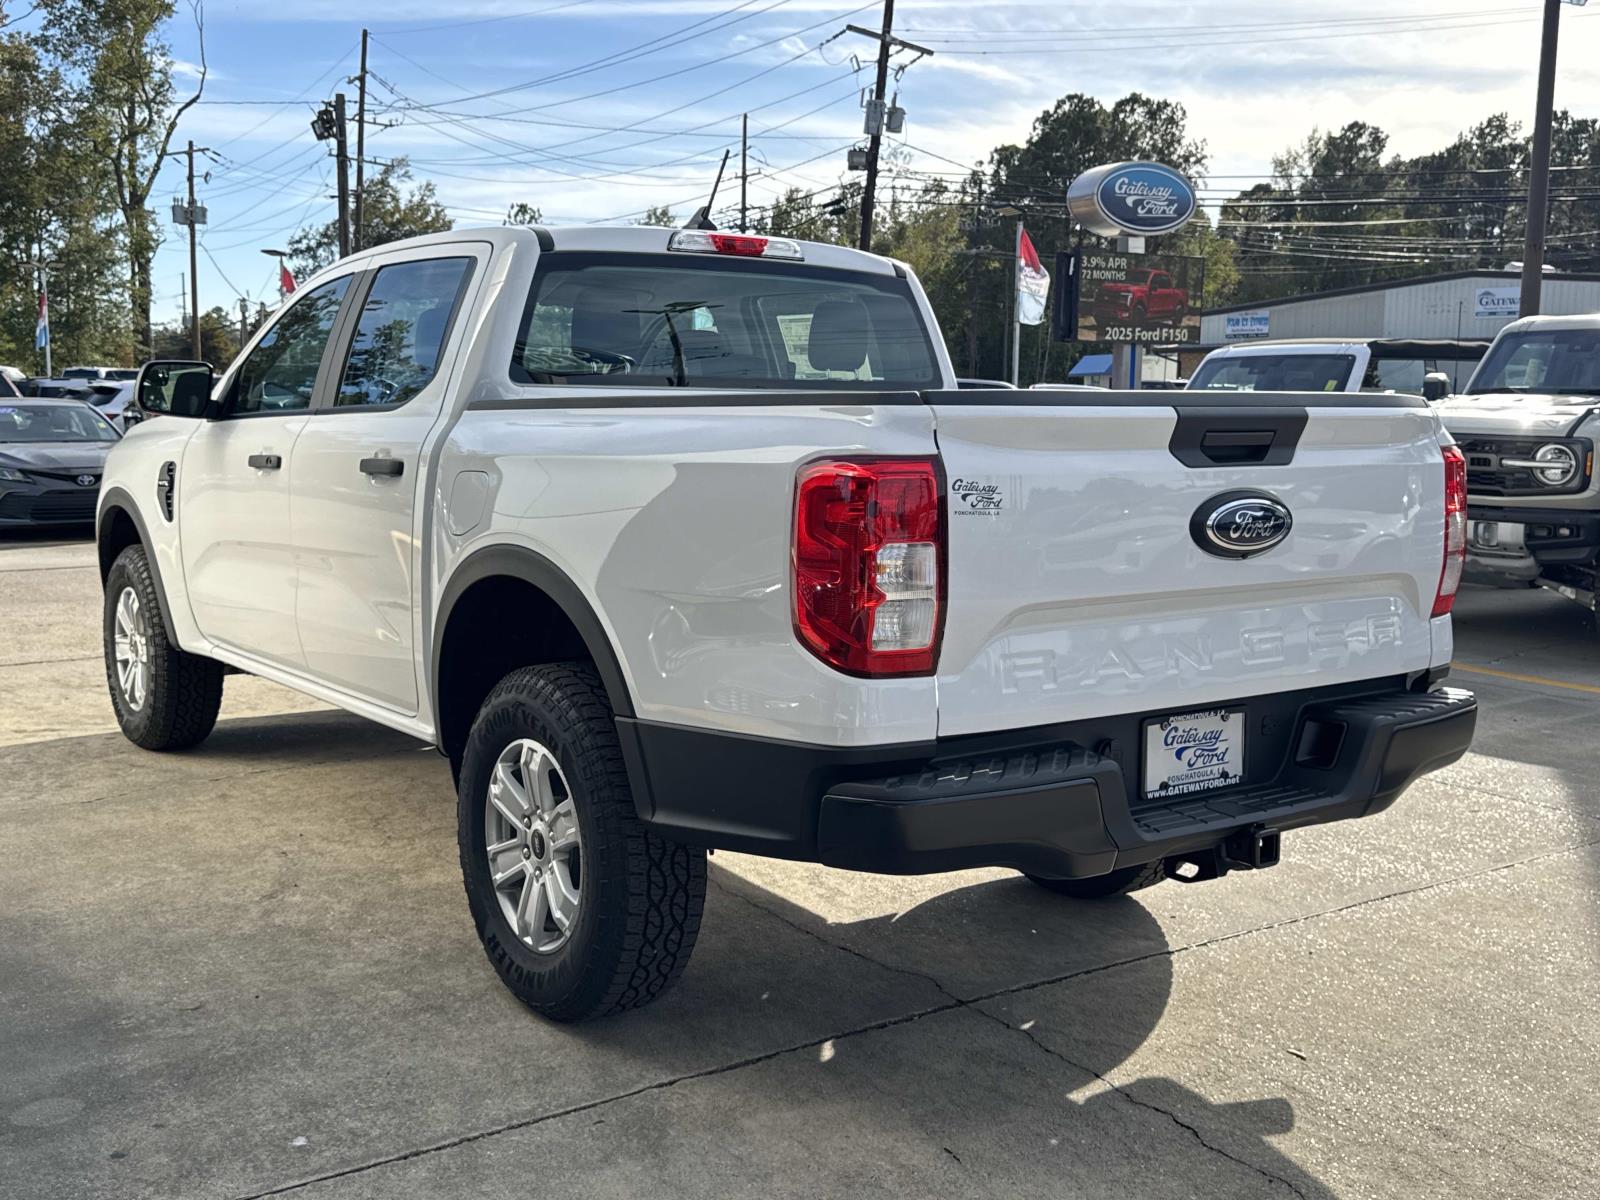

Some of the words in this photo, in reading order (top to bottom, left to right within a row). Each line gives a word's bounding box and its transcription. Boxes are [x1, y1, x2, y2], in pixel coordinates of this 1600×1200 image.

[1114, 177, 1173, 200] Gateway
[1137, 199, 1178, 214] Ford
[1081, 256, 1106, 269] 3.9%
[1107, 257, 1127, 270] APR
[1081, 270, 1092, 280] 72
[1093, 270, 1126, 281] MONTHS
[1479, 296, 1520, 307] GATEW
[1104, 327, 1133, 341] 2025
[1134, 327, 1160, 342] Ford
[1161, 328, 1189, 342] F150
[951, 478, 999, 497] Gateway
[970, 495, 1003, 508] Ford
[1229, 510, 1276, 539] Ford
[1000, 612, 1401, 694] RANGER
[1163, 725, 1224, 748] Gateway
[1187, 747, 1229, 768] Ford
[1147, 775, 1241, 799] www.GATEWAYFORD.net
